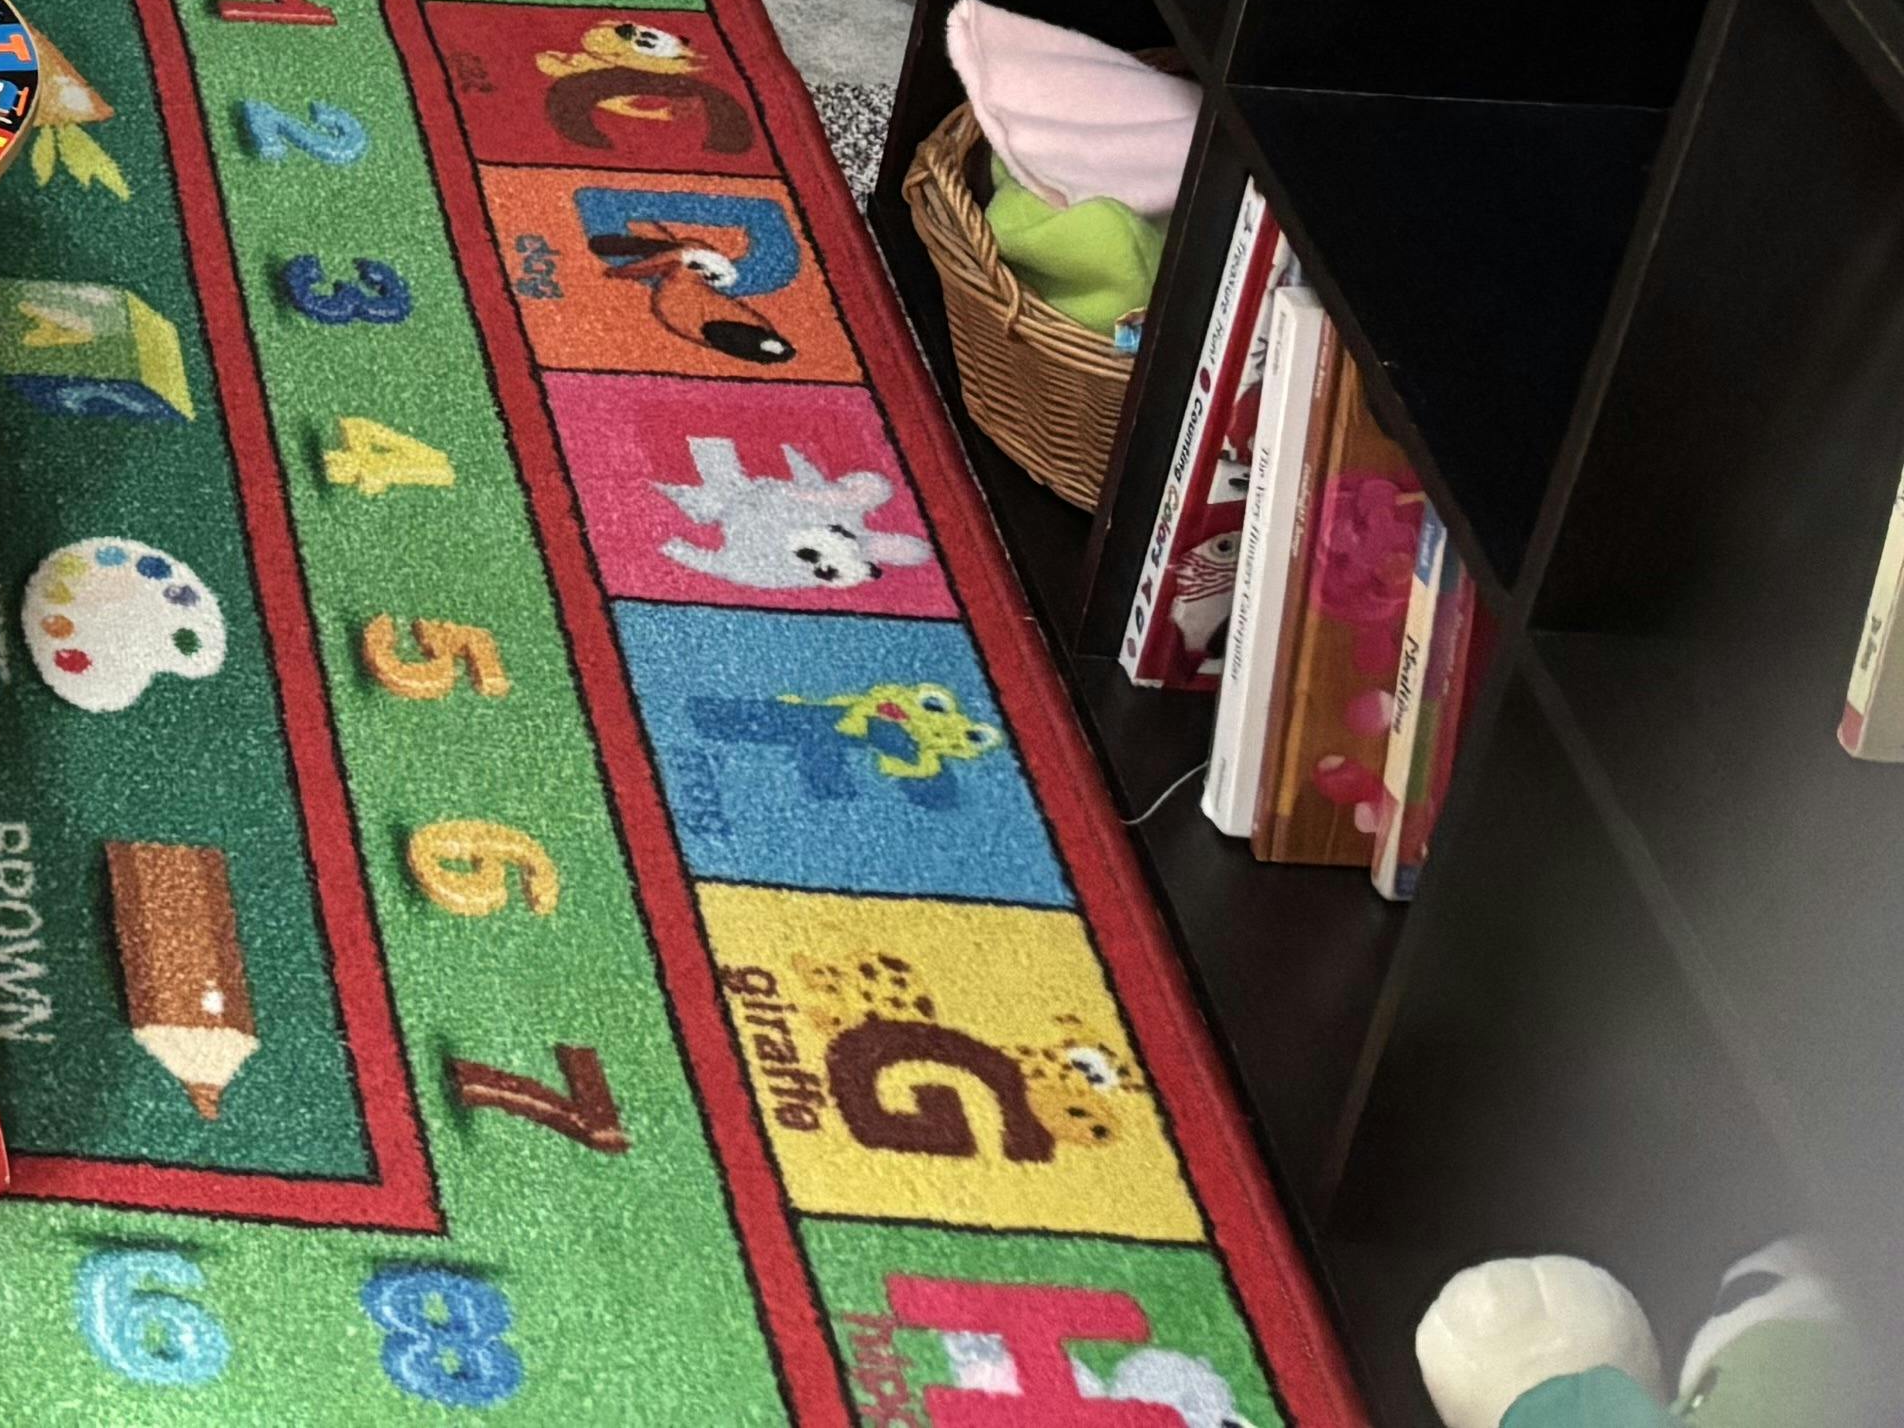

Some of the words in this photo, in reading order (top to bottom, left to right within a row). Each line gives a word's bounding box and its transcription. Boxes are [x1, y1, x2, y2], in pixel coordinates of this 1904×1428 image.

[242, 98, 369, 166] 2
[280, 254, 413, 326] 3
[514, 234, 565, 301] dog
[323, 416, 456, 494] 4
[1173, 397, 1203, 483] Counting
[1149, 483, 1181, 570] Colors
[362, 613, 511, 700] 5
[407, 818, 560, 917] 6
[718, 962, 825, 1134] giraffe
[825, 1016, 1056, 1164] G
[448, 1045, 632, 1156] 7
[73, 1247, 232, 1387] 9
[360, 1261, 525, 1409] 8
